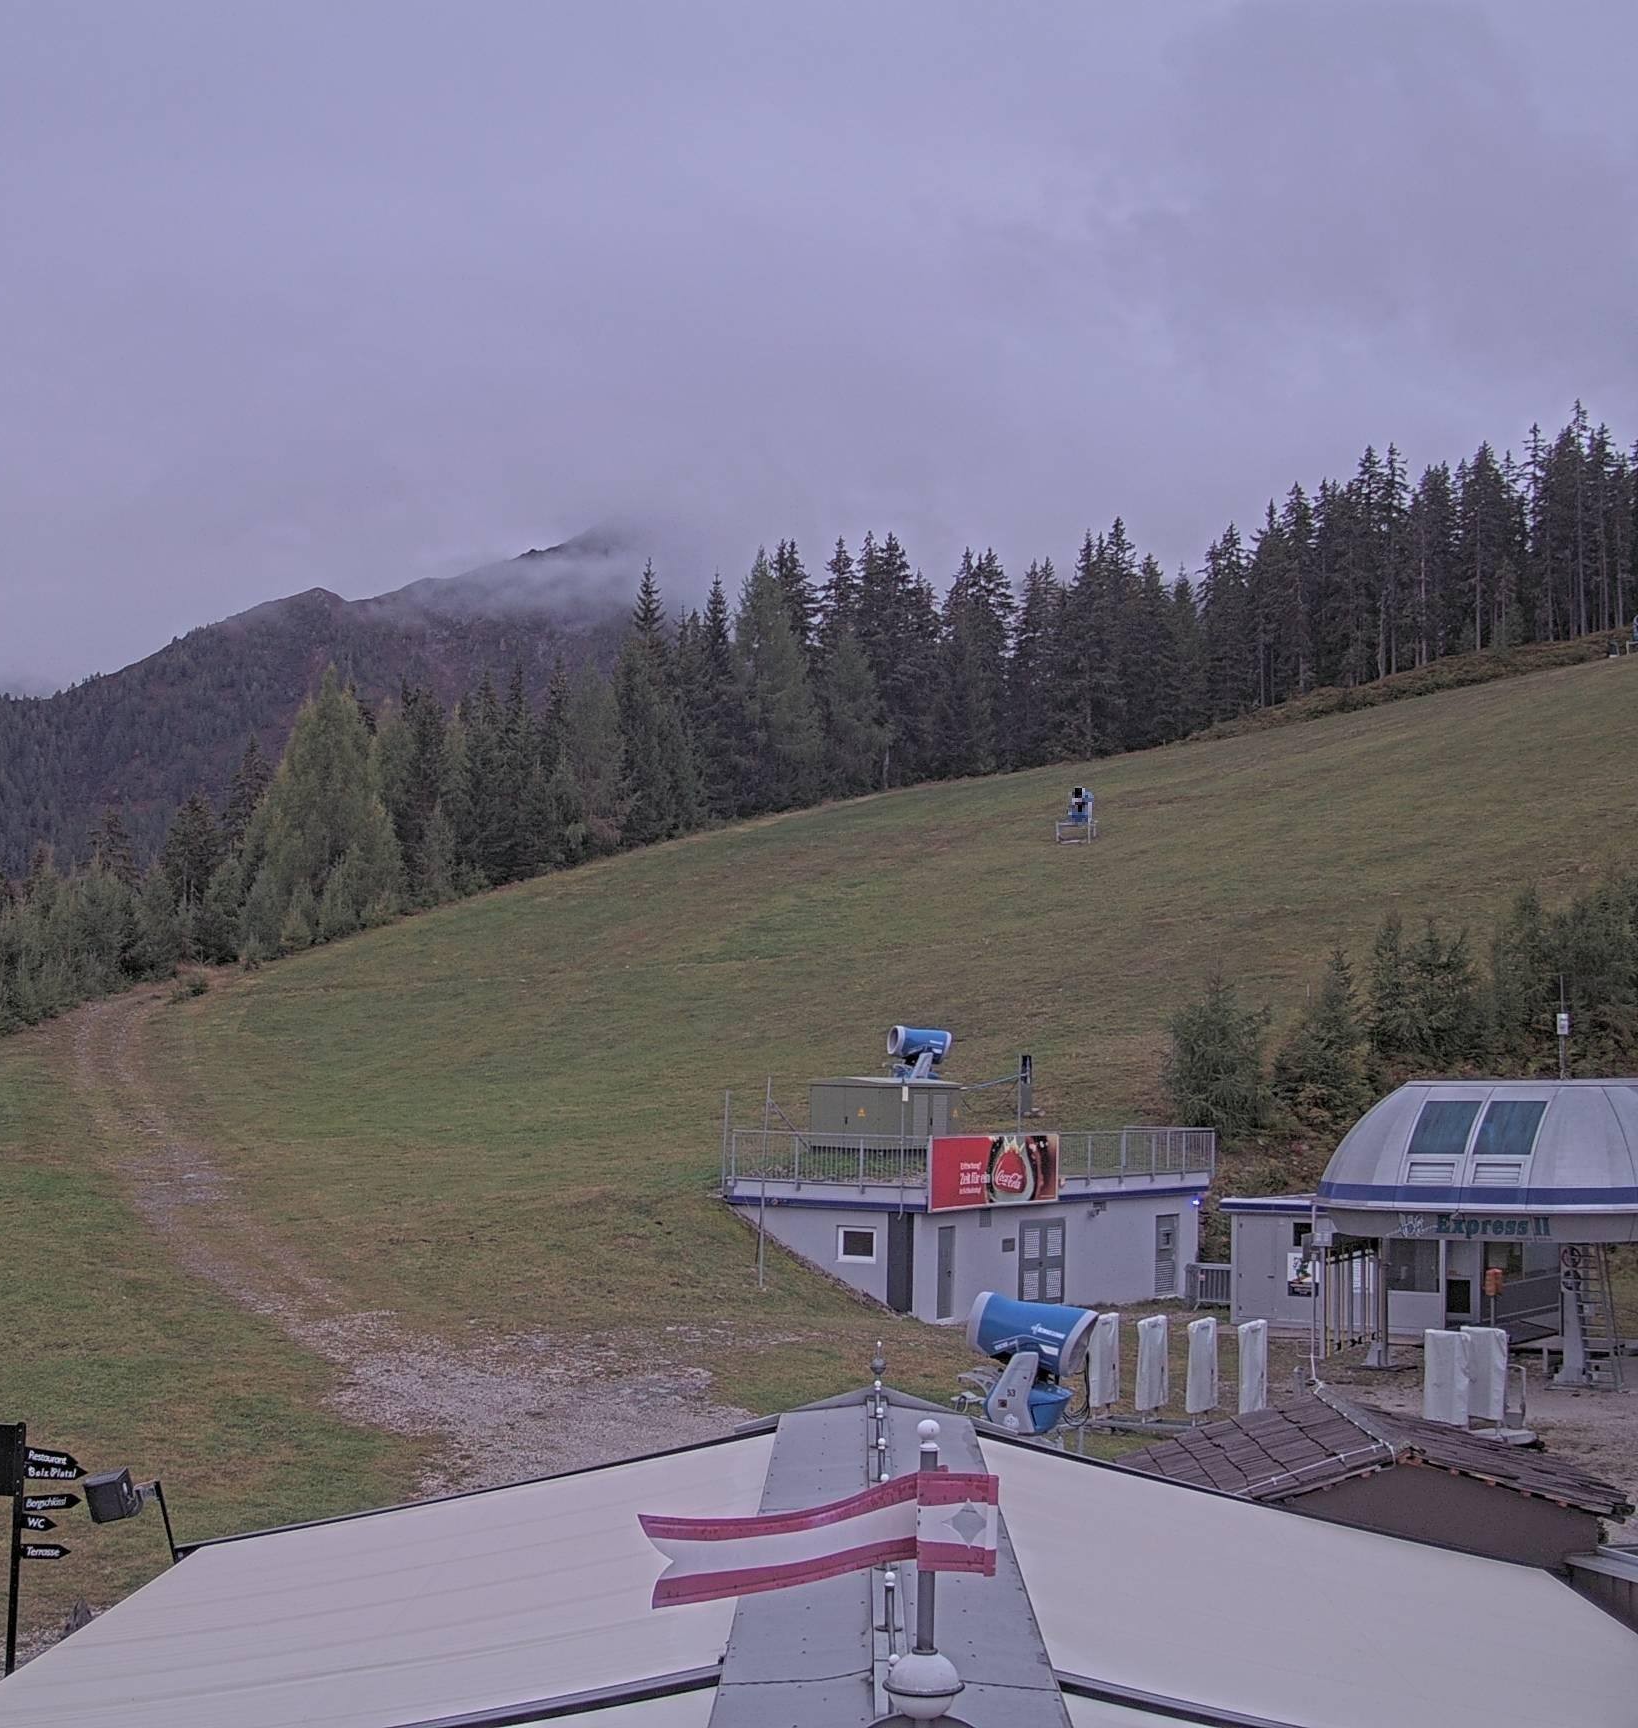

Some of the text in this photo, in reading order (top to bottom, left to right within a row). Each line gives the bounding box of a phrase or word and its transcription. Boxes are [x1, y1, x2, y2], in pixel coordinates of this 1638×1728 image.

[1437, 1213, 1528, 1238] Express
[1533, 1216, 1551, 1236] II
[1007, 1388, 1016, 1397] 53
[28, 1449, 67, 1465] Restaurant
[27, 1516, 46, 1529] WC
[26, 1546, 61, 1558] Terrasse
